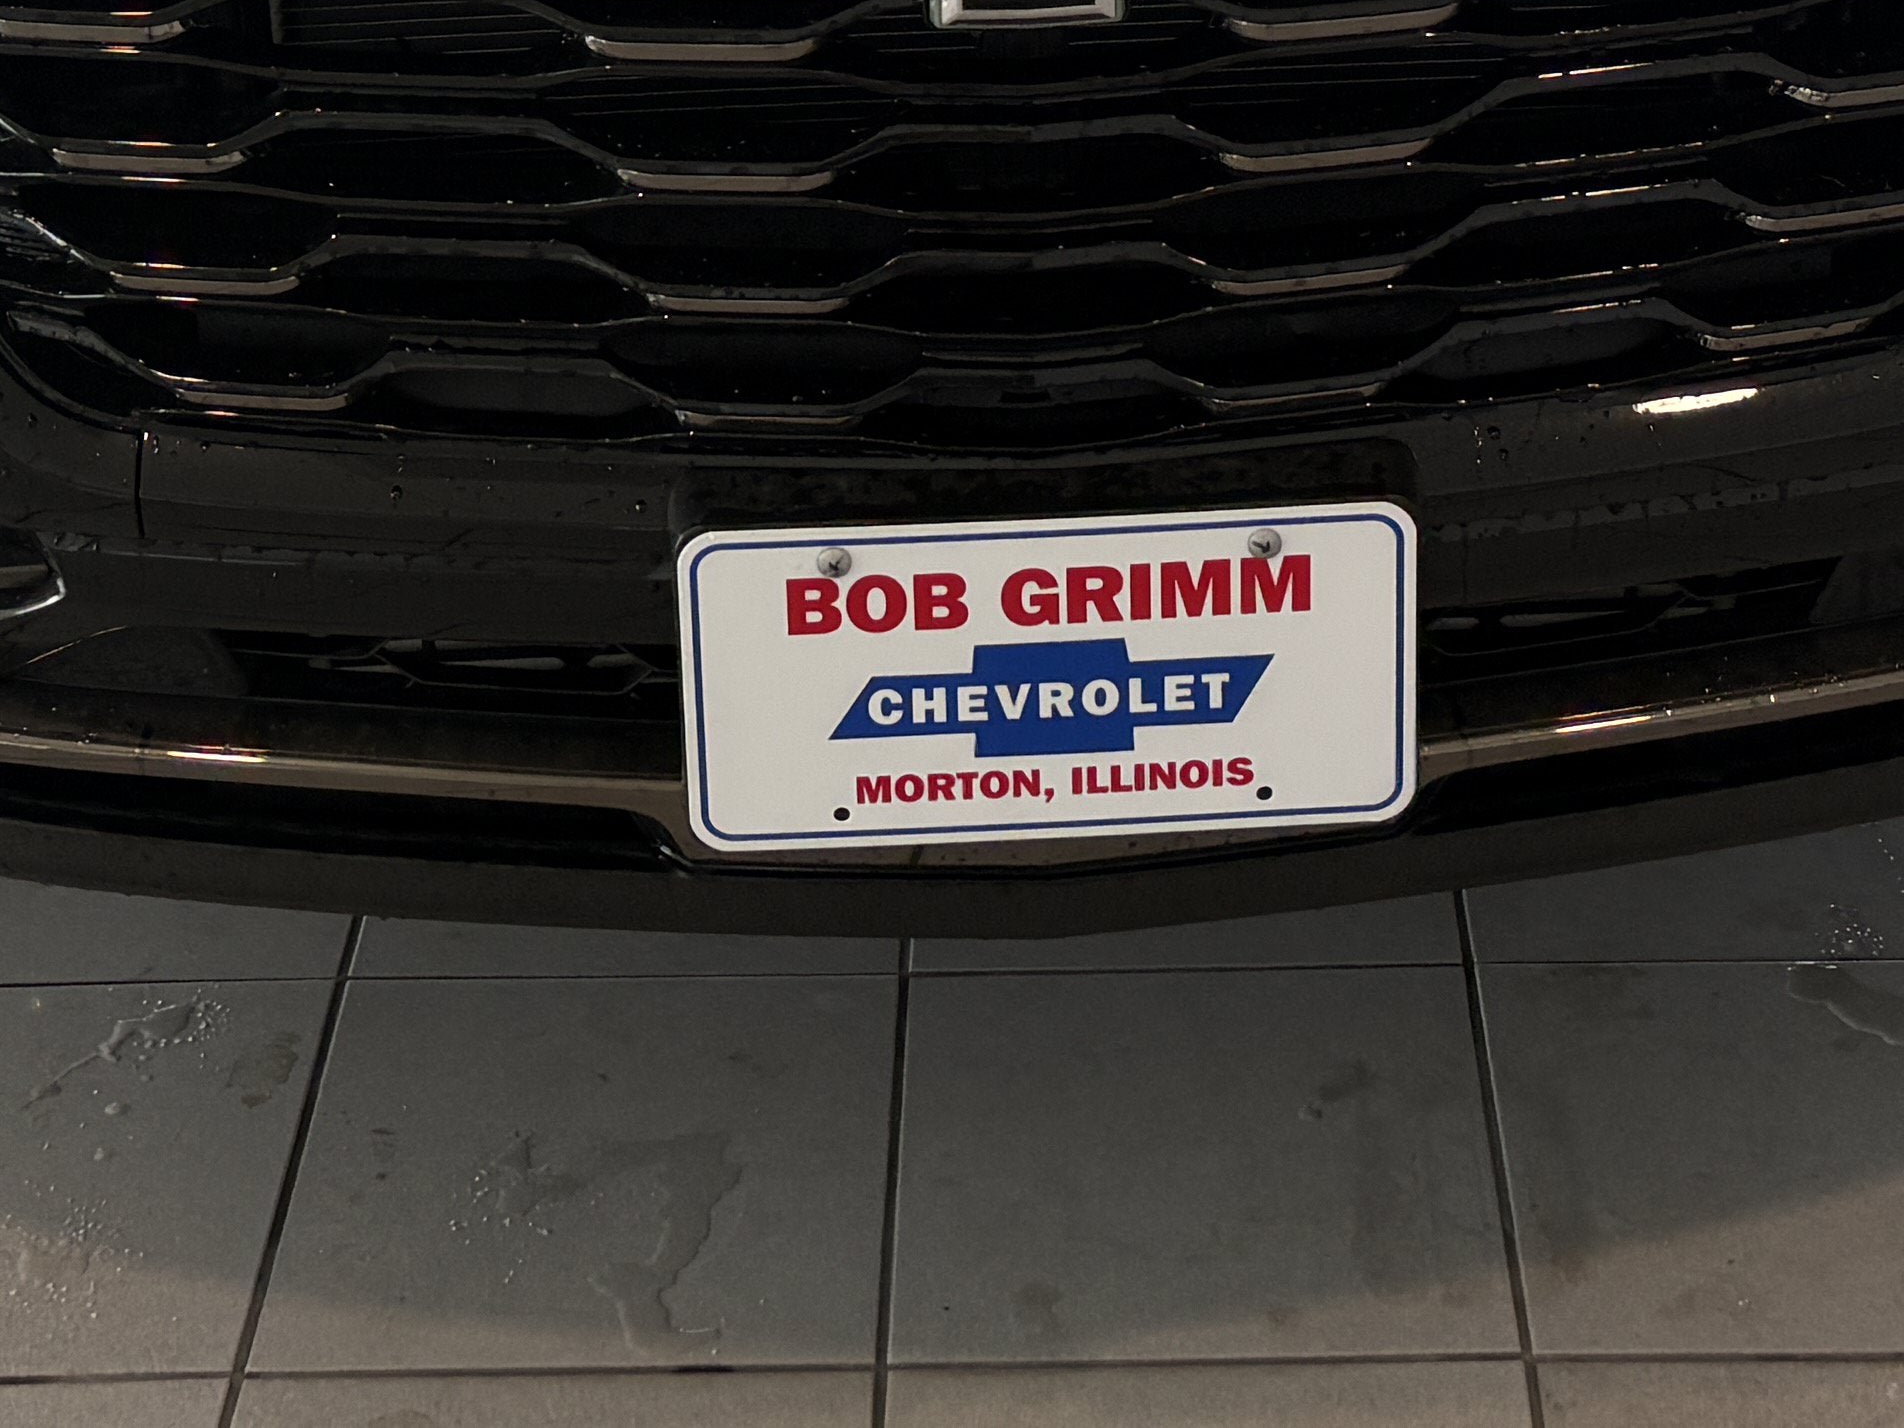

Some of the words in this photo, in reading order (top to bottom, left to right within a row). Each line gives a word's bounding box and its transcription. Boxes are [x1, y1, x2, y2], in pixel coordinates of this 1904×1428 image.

[785, 572, 970, 636] BOB
[1000, 554, 1312, 628] GRIMM
[867, 671, 1231, 726] CHEVROLET
[856, 767, 1055, 805] MORTON,
[1071, 757, 1255, 796] ILLINOIS
